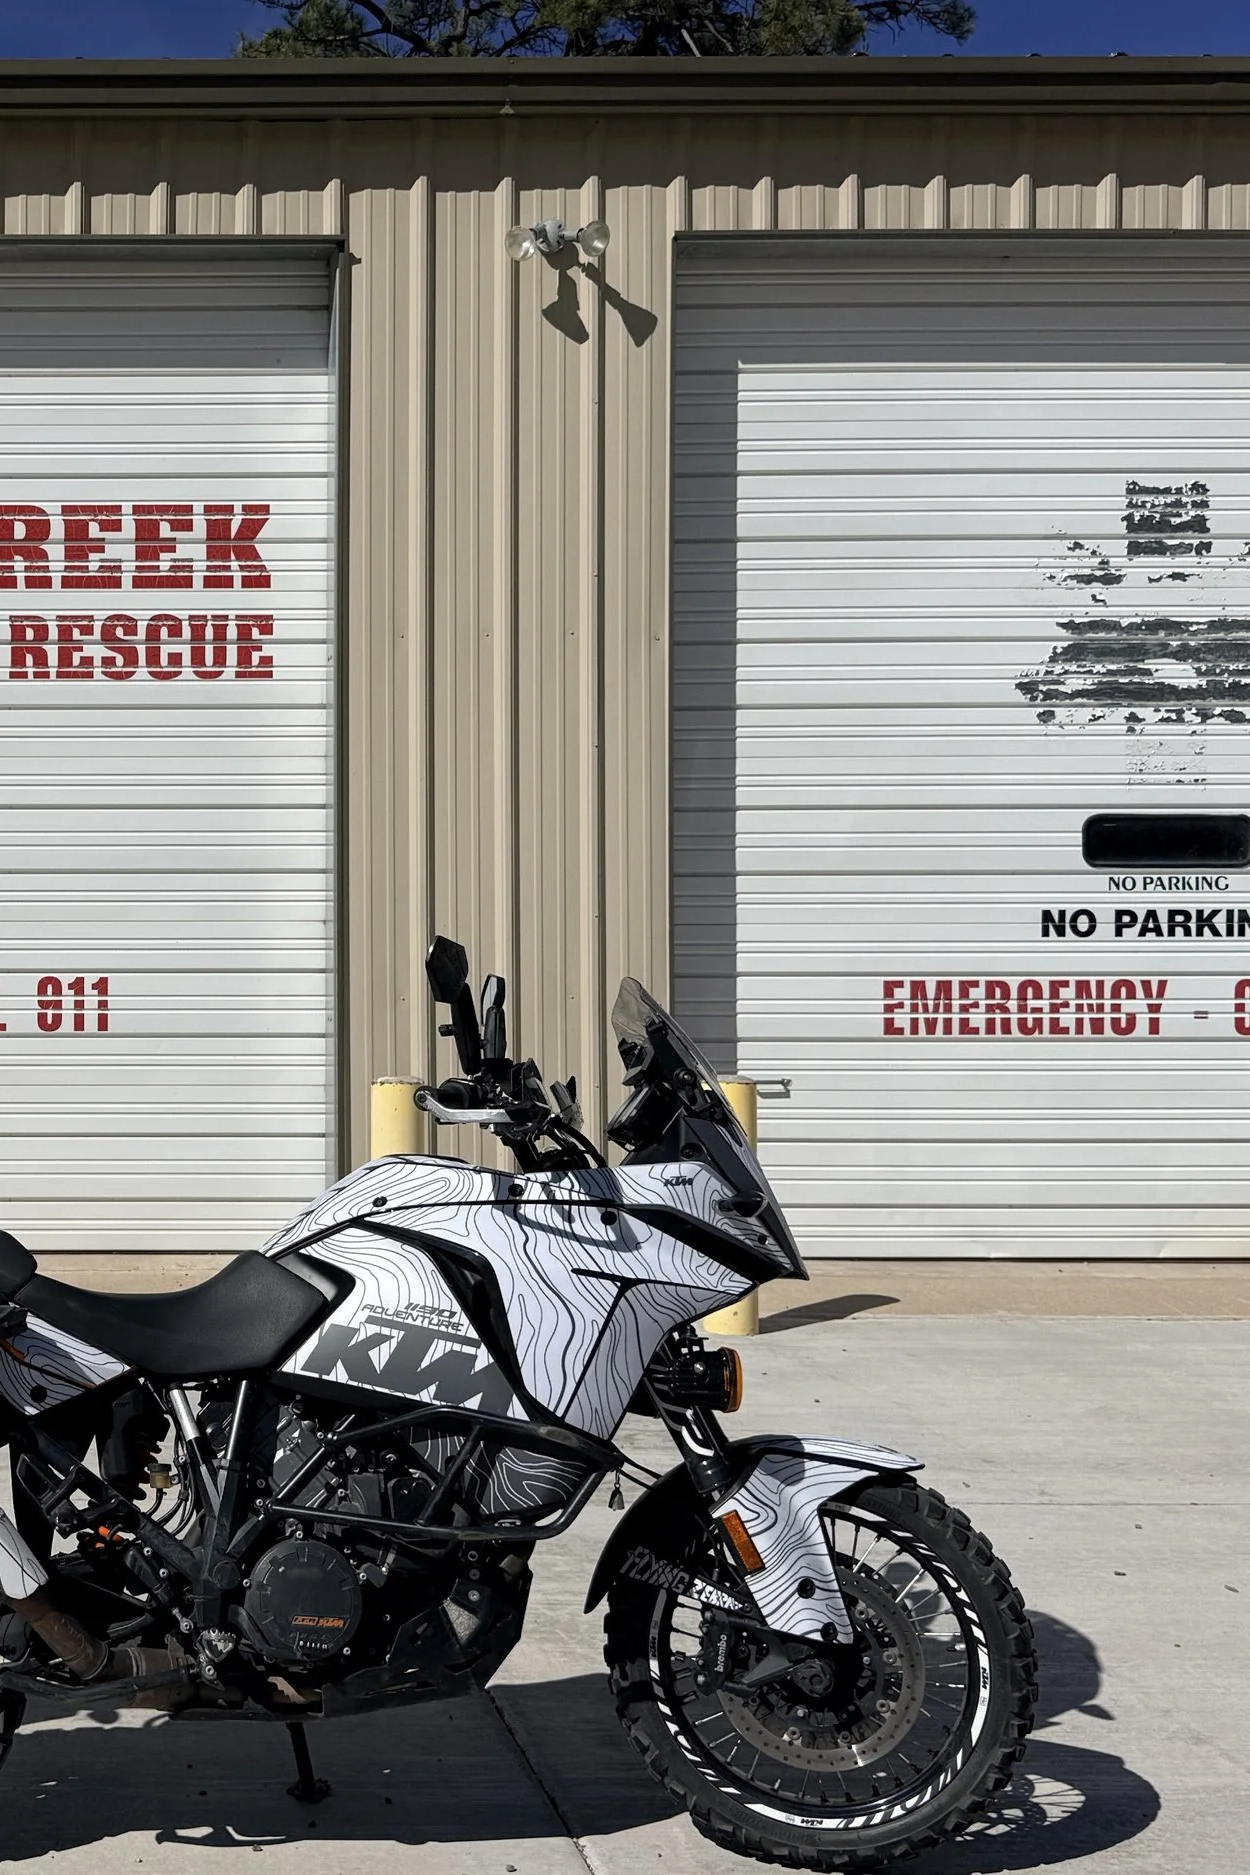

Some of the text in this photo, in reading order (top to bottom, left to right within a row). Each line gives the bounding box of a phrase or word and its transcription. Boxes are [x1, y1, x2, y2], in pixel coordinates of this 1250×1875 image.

[9, 613, 274, 681] RESCUE
[1108, 876, 1229, 891] NO PARKING
[1041, 908, 1097, 938] NO
[37, 976, 109, 1032] 911
[883, 979, 1168, 1037] EMERGENCY
[663, 1175, 693, 1187] KTM
[361, 1303, 464, 1332] ADVENTURE
[403, 1302, 458, 1320] 1190
[300, 1314, 514, 1415] KTM
[714, 1634, 728, 1673] brembo
